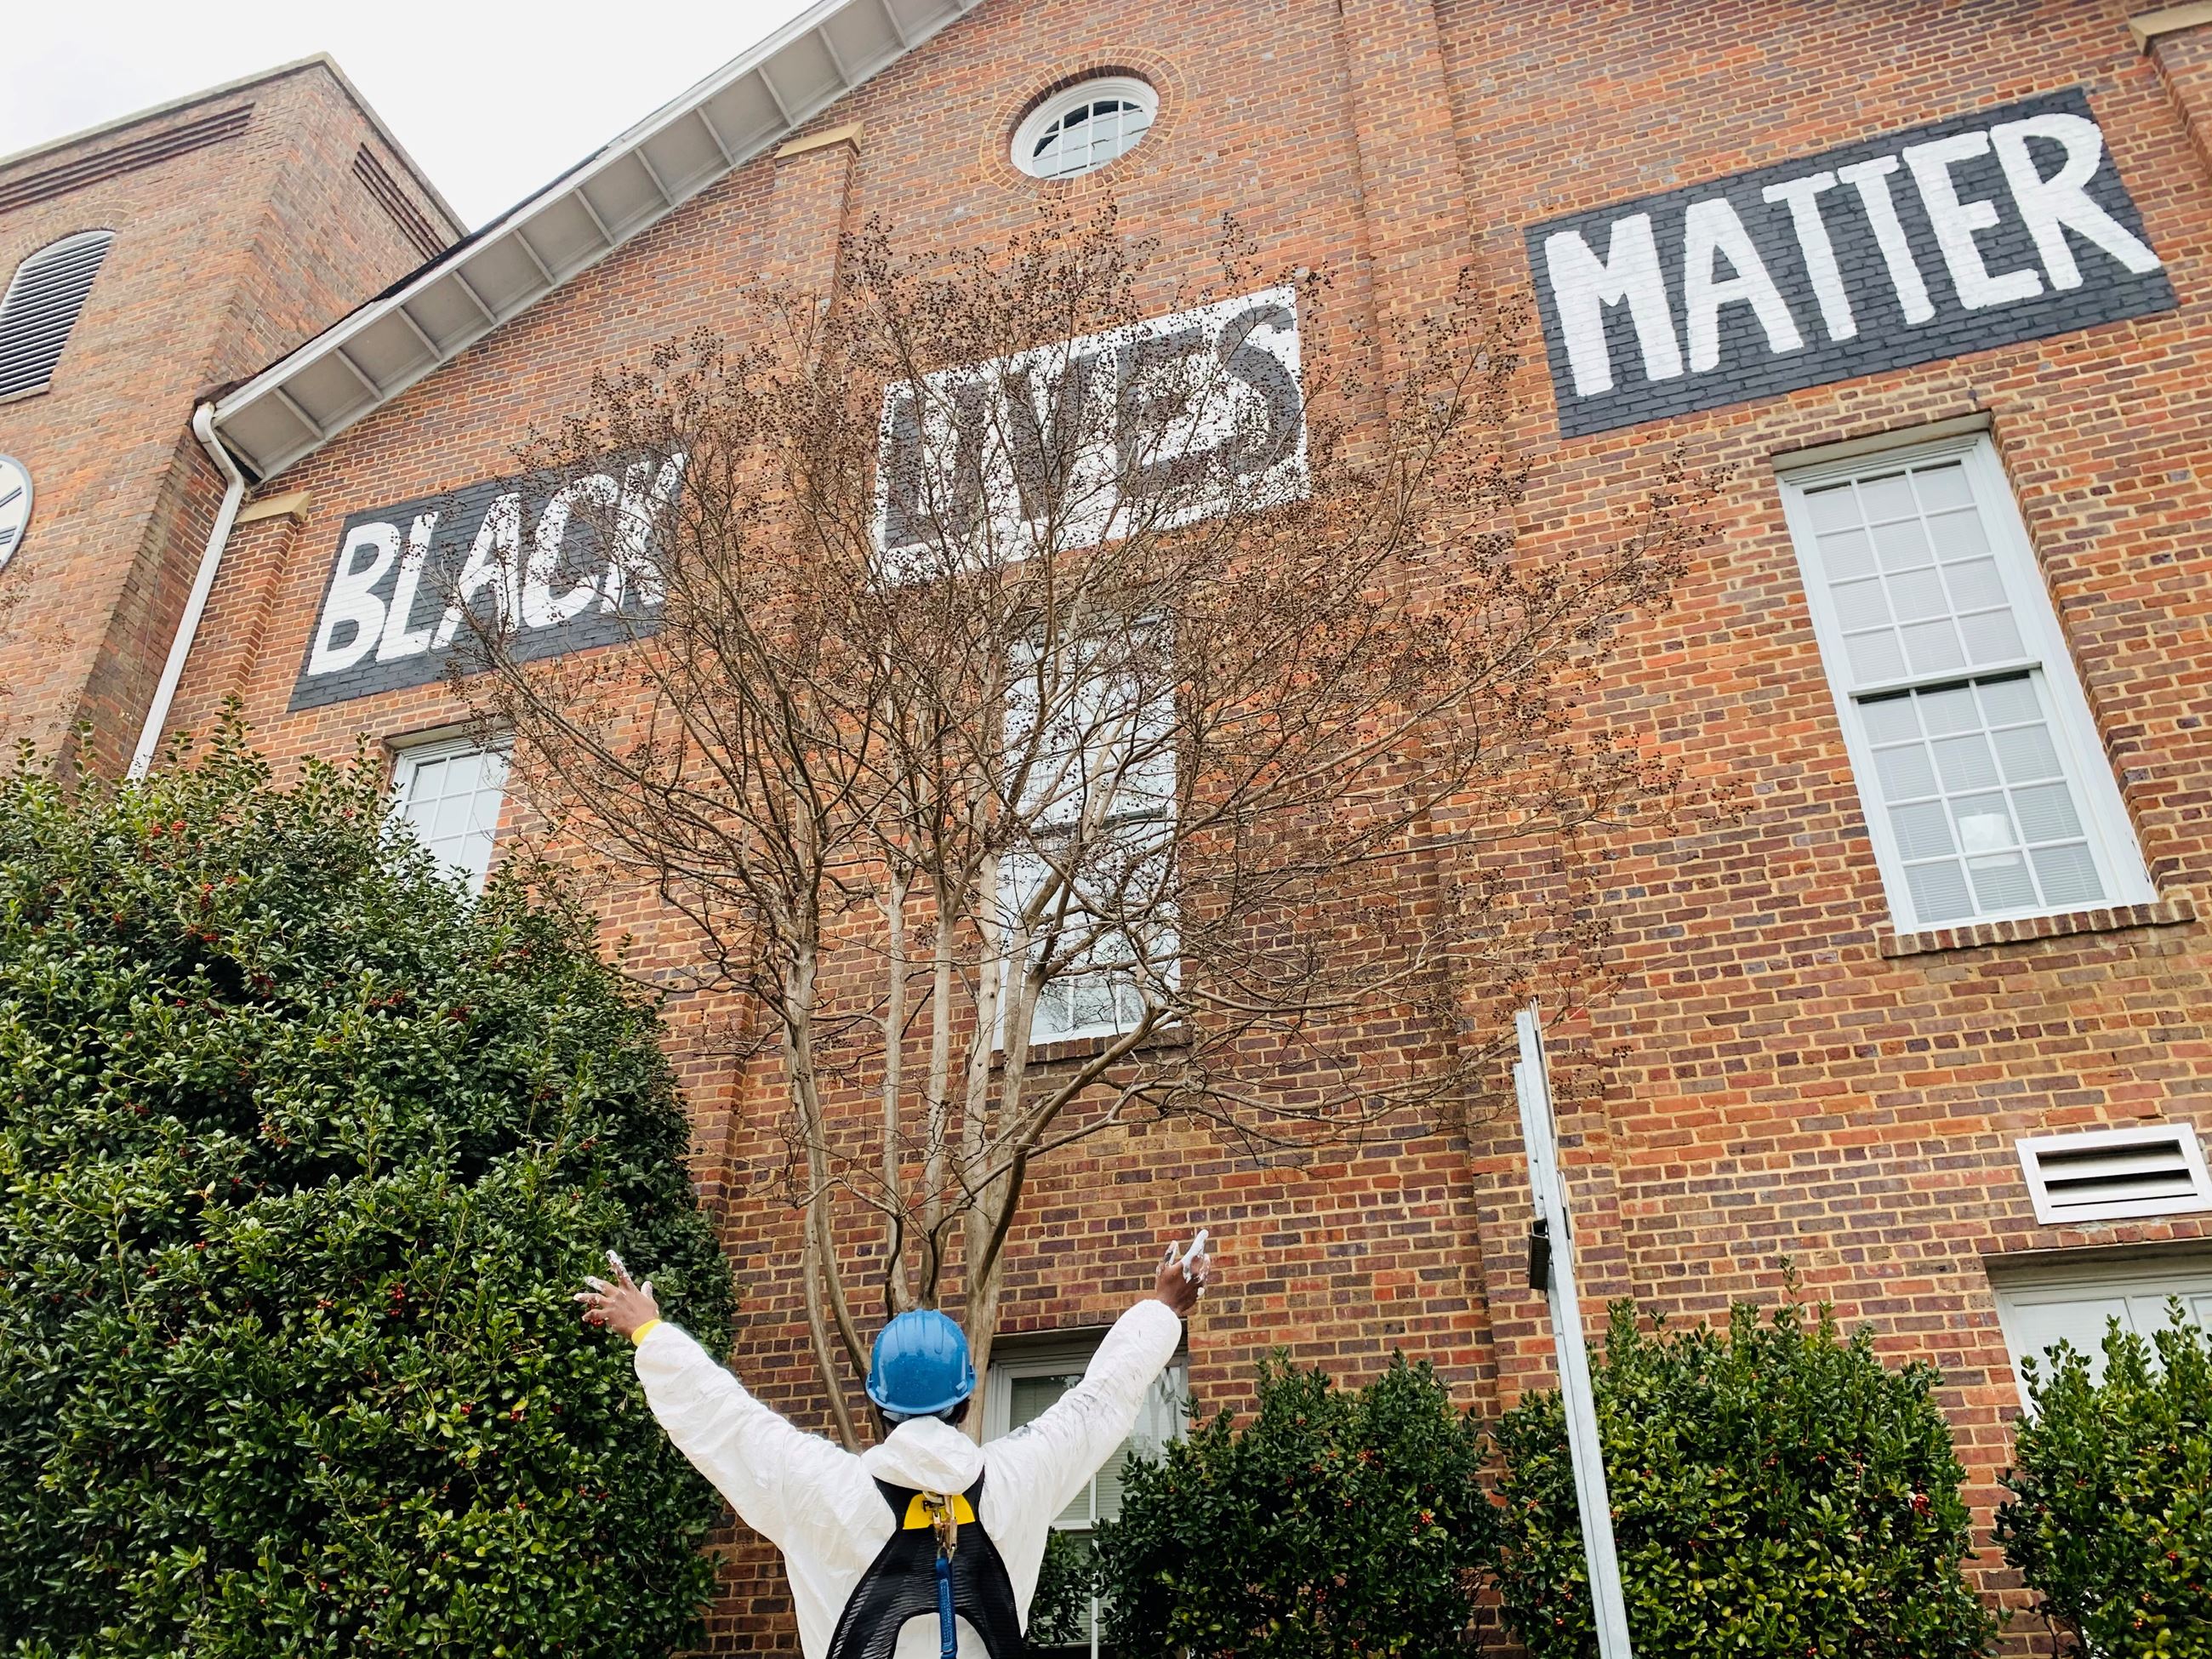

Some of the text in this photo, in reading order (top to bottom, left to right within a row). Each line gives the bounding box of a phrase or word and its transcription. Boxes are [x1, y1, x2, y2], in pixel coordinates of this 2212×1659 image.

[308, 113, 2162, 676] BLACK LIVES MATTER
